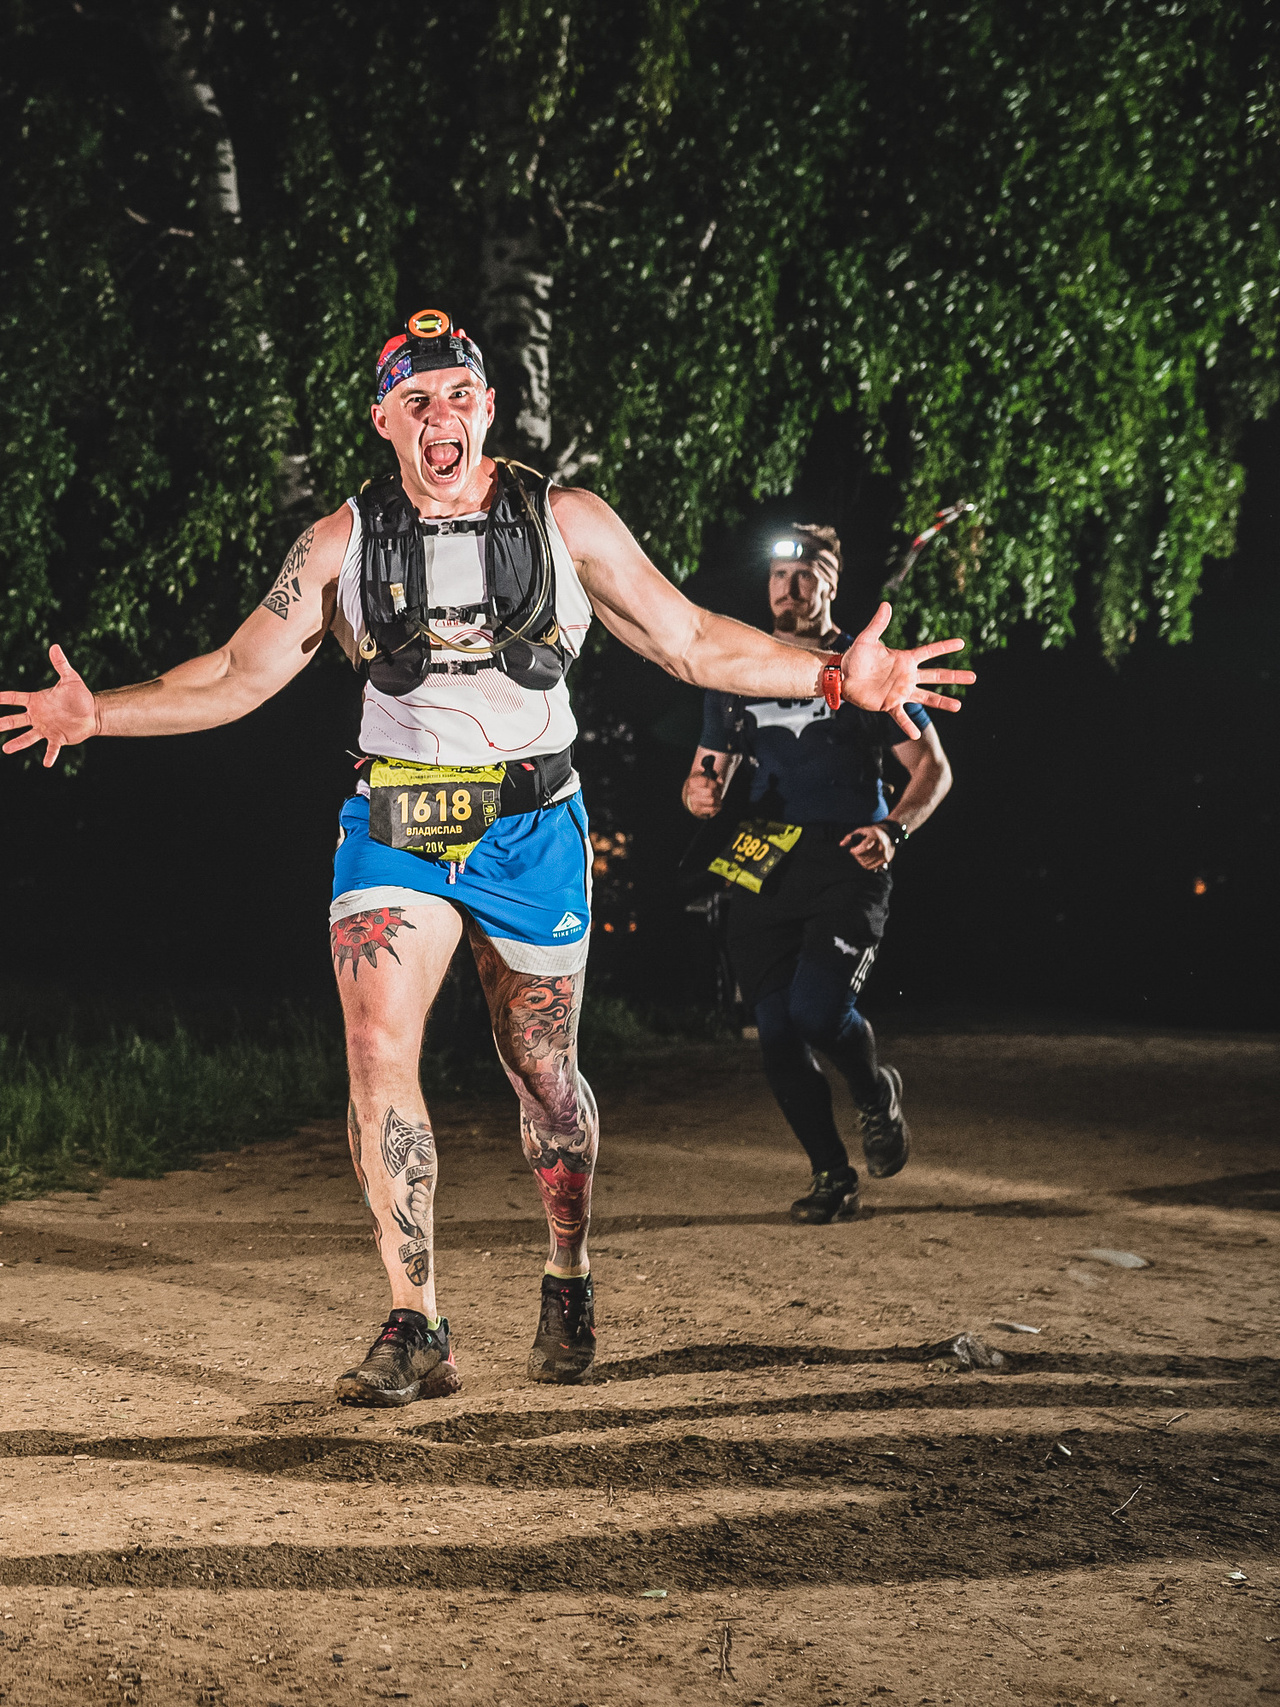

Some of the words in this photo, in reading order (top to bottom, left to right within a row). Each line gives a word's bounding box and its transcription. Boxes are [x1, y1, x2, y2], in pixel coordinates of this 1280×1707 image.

[397, 789, 472, 823] 1618
[406, 825, 463, 836] ВЛАДИСЛАВ
[425, 841, 445, 853] 20K
[732, 832, 770, 861] 1380
